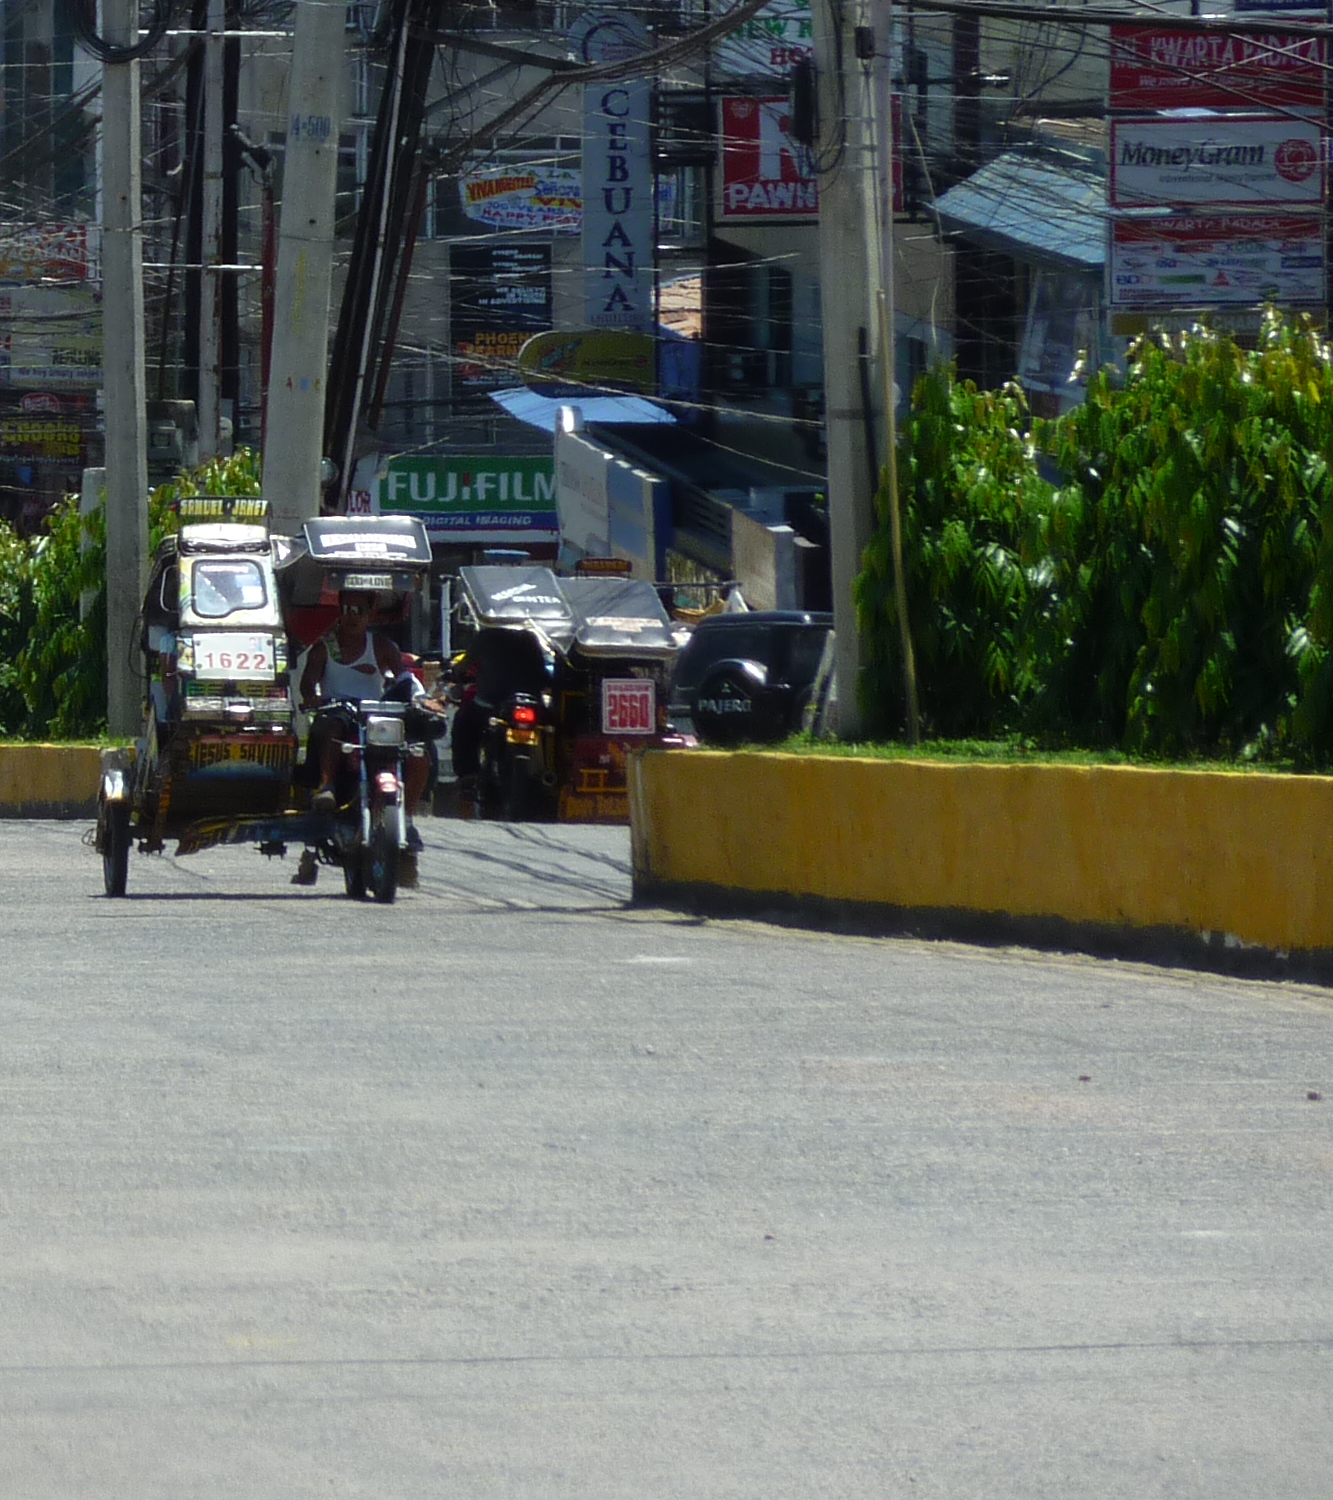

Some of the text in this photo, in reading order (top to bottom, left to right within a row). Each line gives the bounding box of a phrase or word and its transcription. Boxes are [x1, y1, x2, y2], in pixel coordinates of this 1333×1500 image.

[1122, 141, 1265, 170] MoneyGram
[601, 89, 636, 312] CEBUANA
[387, 471, 557, 502] FUJIFILM
[204, 652, 267, 671] 1622
[698, 699, 751, 713] PAJERO
